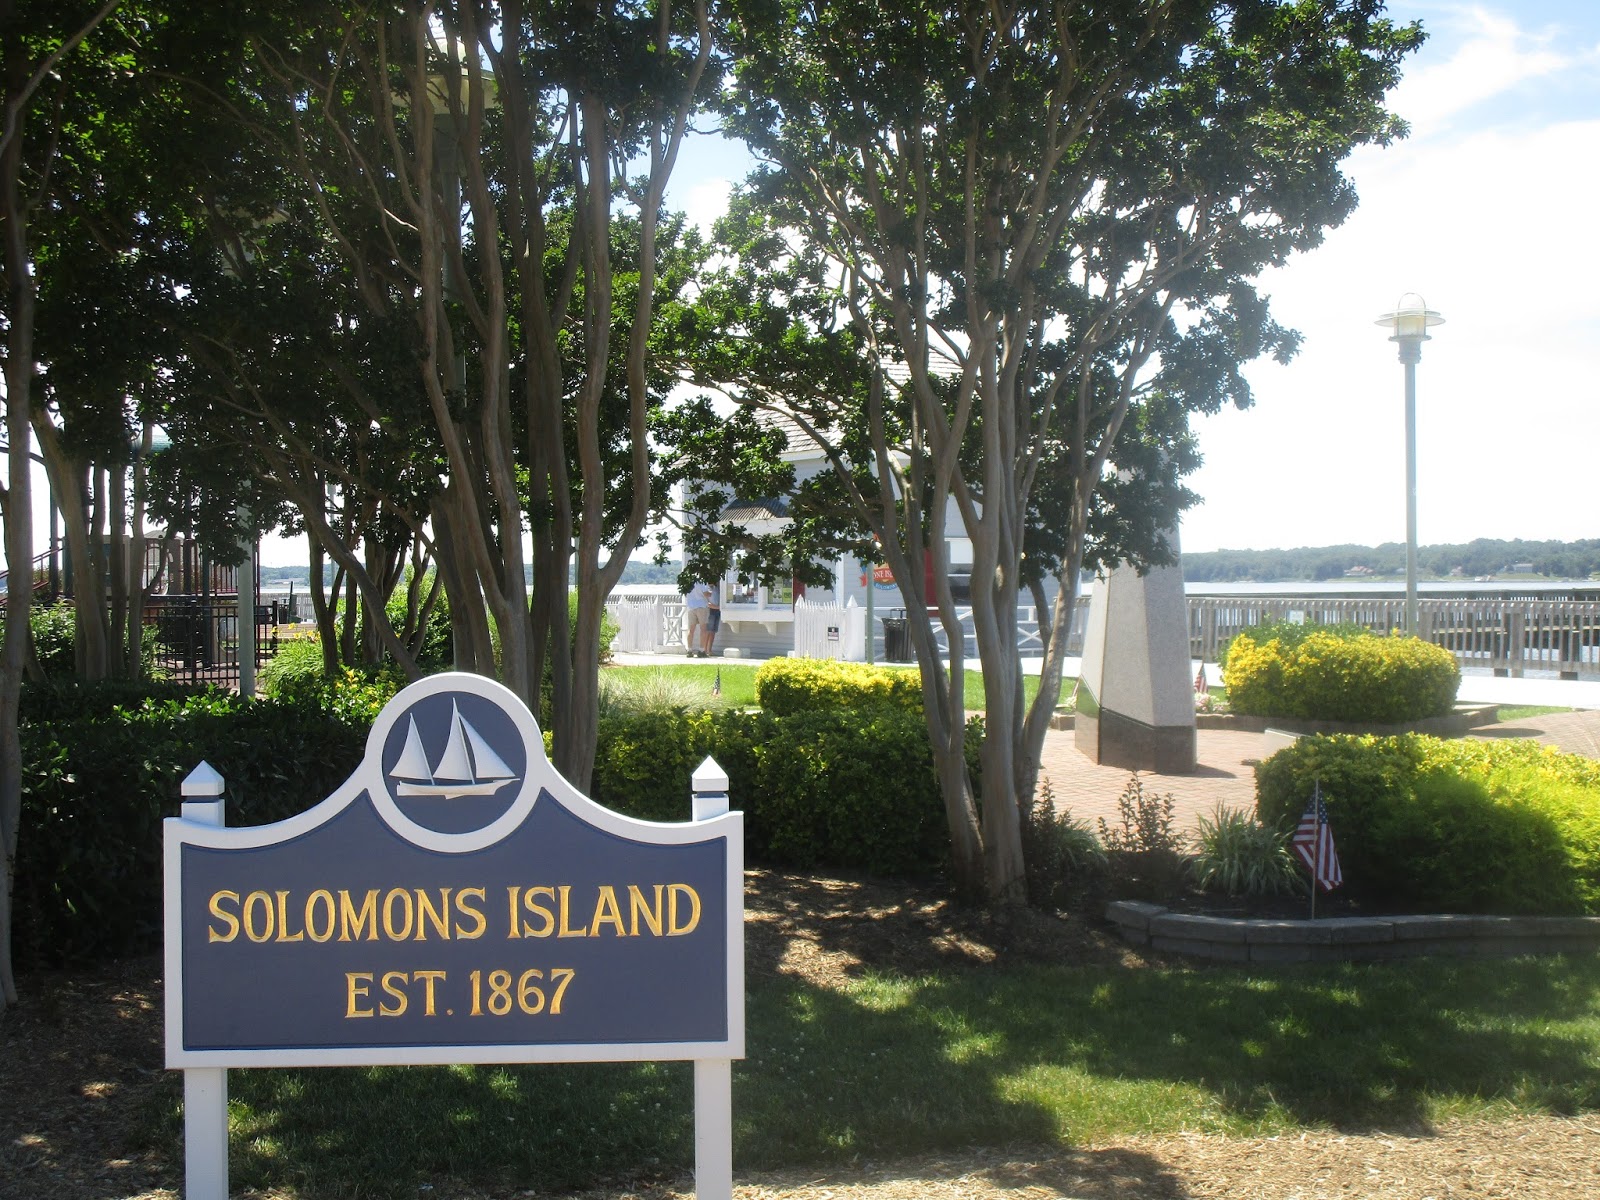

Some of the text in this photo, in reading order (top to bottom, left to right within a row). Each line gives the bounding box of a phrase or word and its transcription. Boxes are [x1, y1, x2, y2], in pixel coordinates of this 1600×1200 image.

[208, 883, 702, 943] SOLOMONS ISLAND
[345, 968, 575, 1018] EST. 1867
